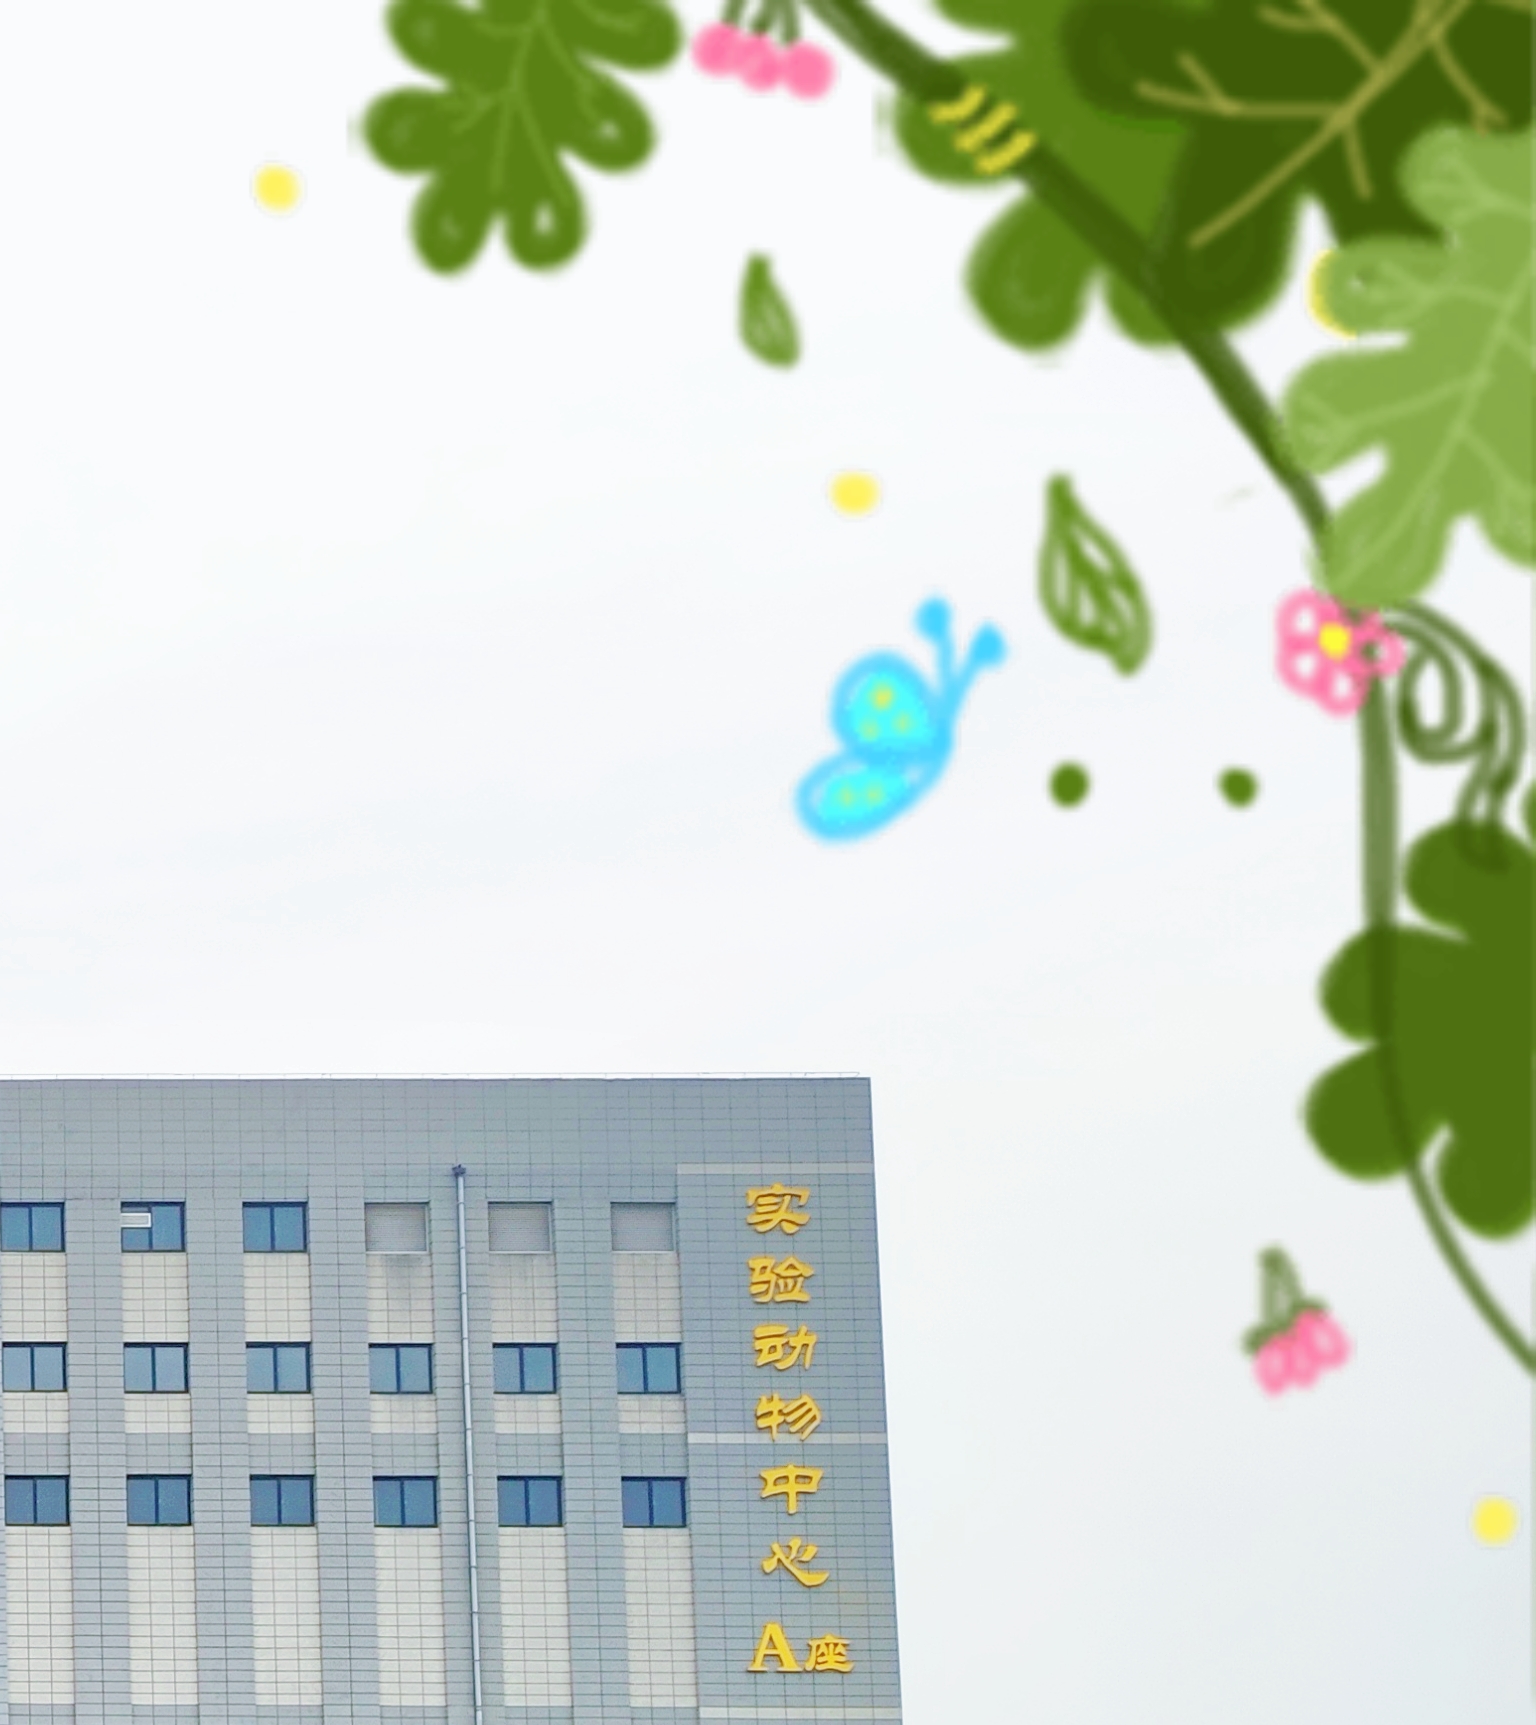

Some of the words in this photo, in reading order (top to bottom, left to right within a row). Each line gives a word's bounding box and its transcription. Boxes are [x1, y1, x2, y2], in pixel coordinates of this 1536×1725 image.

[745, 1182, 830, 1588] 实验动物中心
[746, 1621, 855, 1675] A座
